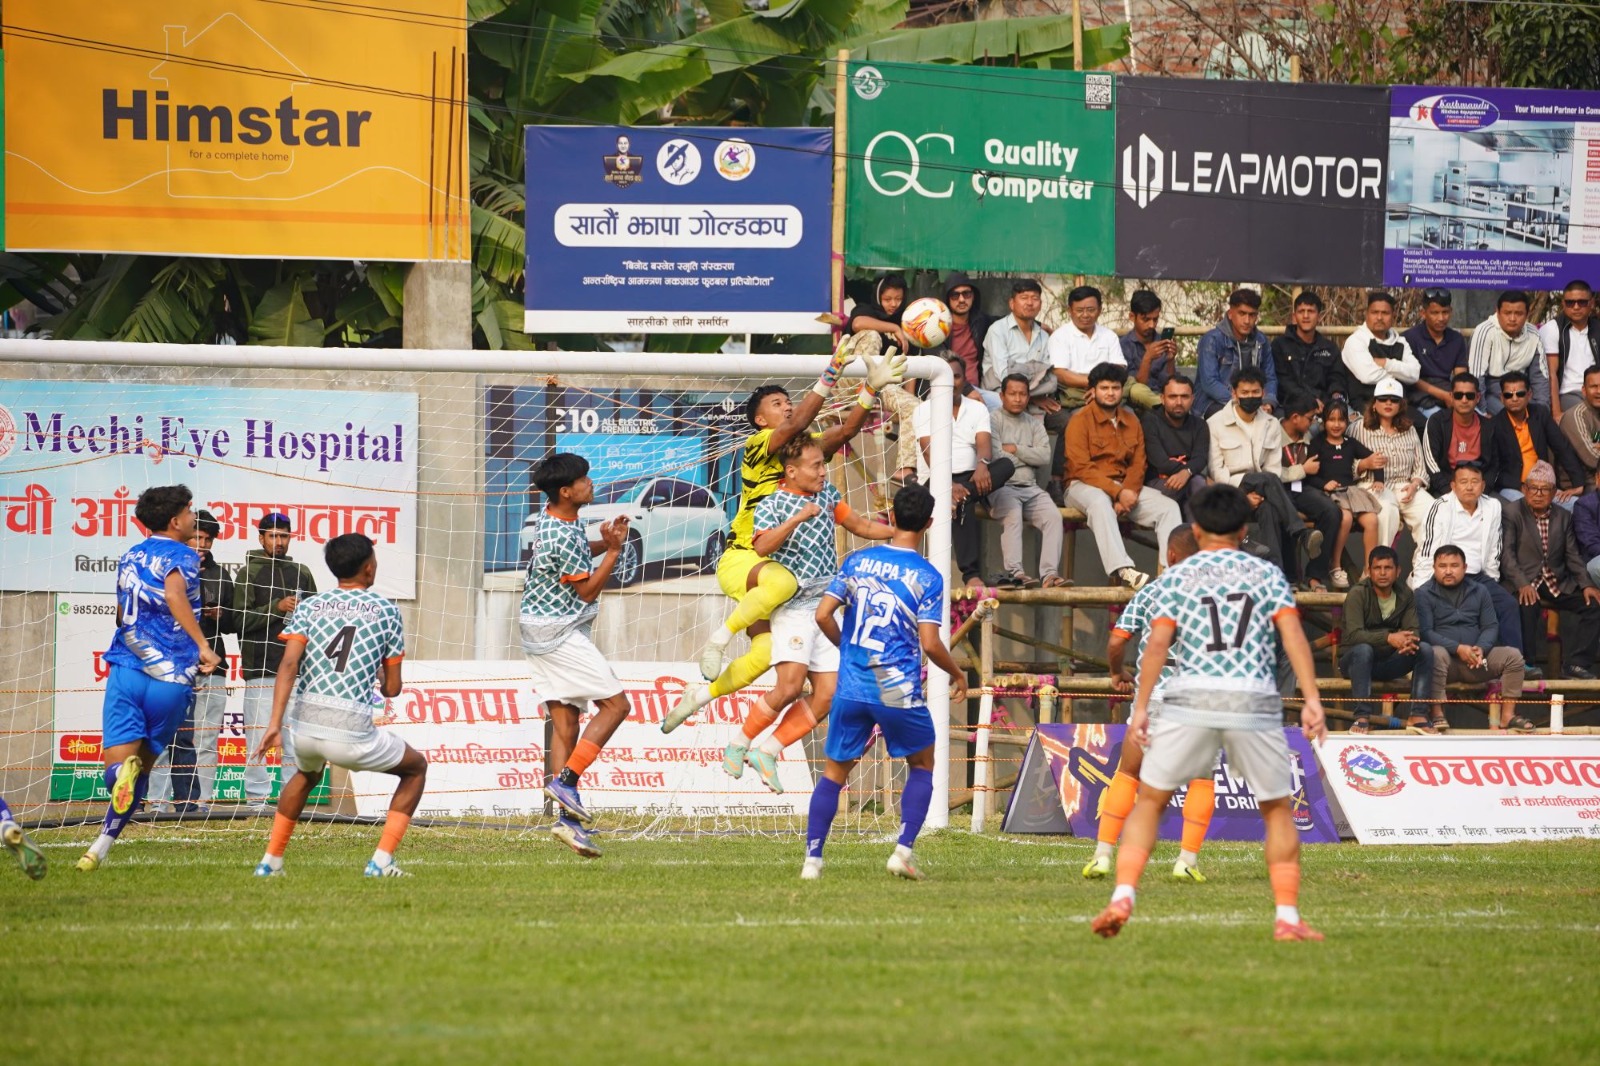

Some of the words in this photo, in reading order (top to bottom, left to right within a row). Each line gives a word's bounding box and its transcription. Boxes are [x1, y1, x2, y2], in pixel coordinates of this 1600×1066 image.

[102, 88, 372, 148] Himstar
[1514, 104, 1529, 114] Your
[1530, 105, 1553, 114] Trusted
[1554, 105, 1577, 114] Partner
[1578, 106, 1585, 114] in
[189, 149, 203, 160] for
[214, 150, 259, 163] complete
[262, 151, 289, 161] home
[864, 130, 955, 198] QC
[984, 138, 1079, 173] Quality
[971, 170, 1094, 203] Computer
[1171, 150, 1382, 199] LEAPMOTOR
[569, 208, 620, 235] सातौं
[627, 216, 682, 236] झापा
[688, 210, 788, 236] गोल्डकप
[672, 315, 693, 327] लागि
[601, 426, 635, 434] PREMIUM
[602, 418, 618, 427] ALL
[619, 418, 657, 427] ELECTRIC
[702, 413, 748, 421] LEAPMOTO
[22, 411, 144, 455] Mechi
[158, 416, 231, 469] Eye
[243, 419, 404, 472] Hospital
[0, 483, 57, 535] ची
[855, 558, 899, 580] JHAPA
[901, 568, 919, 585] XI
[314, 601, 382, 615] SINGLING
[850, 586, 897, 653] 12
[1201, 593, 1255, 652] 17
[324, 625, 357, 673] 4
[402, 688, 521, 724] झापा
[609, 767, 665, 788] नेपाल
[1225, 795, 1259, 810] DRI
